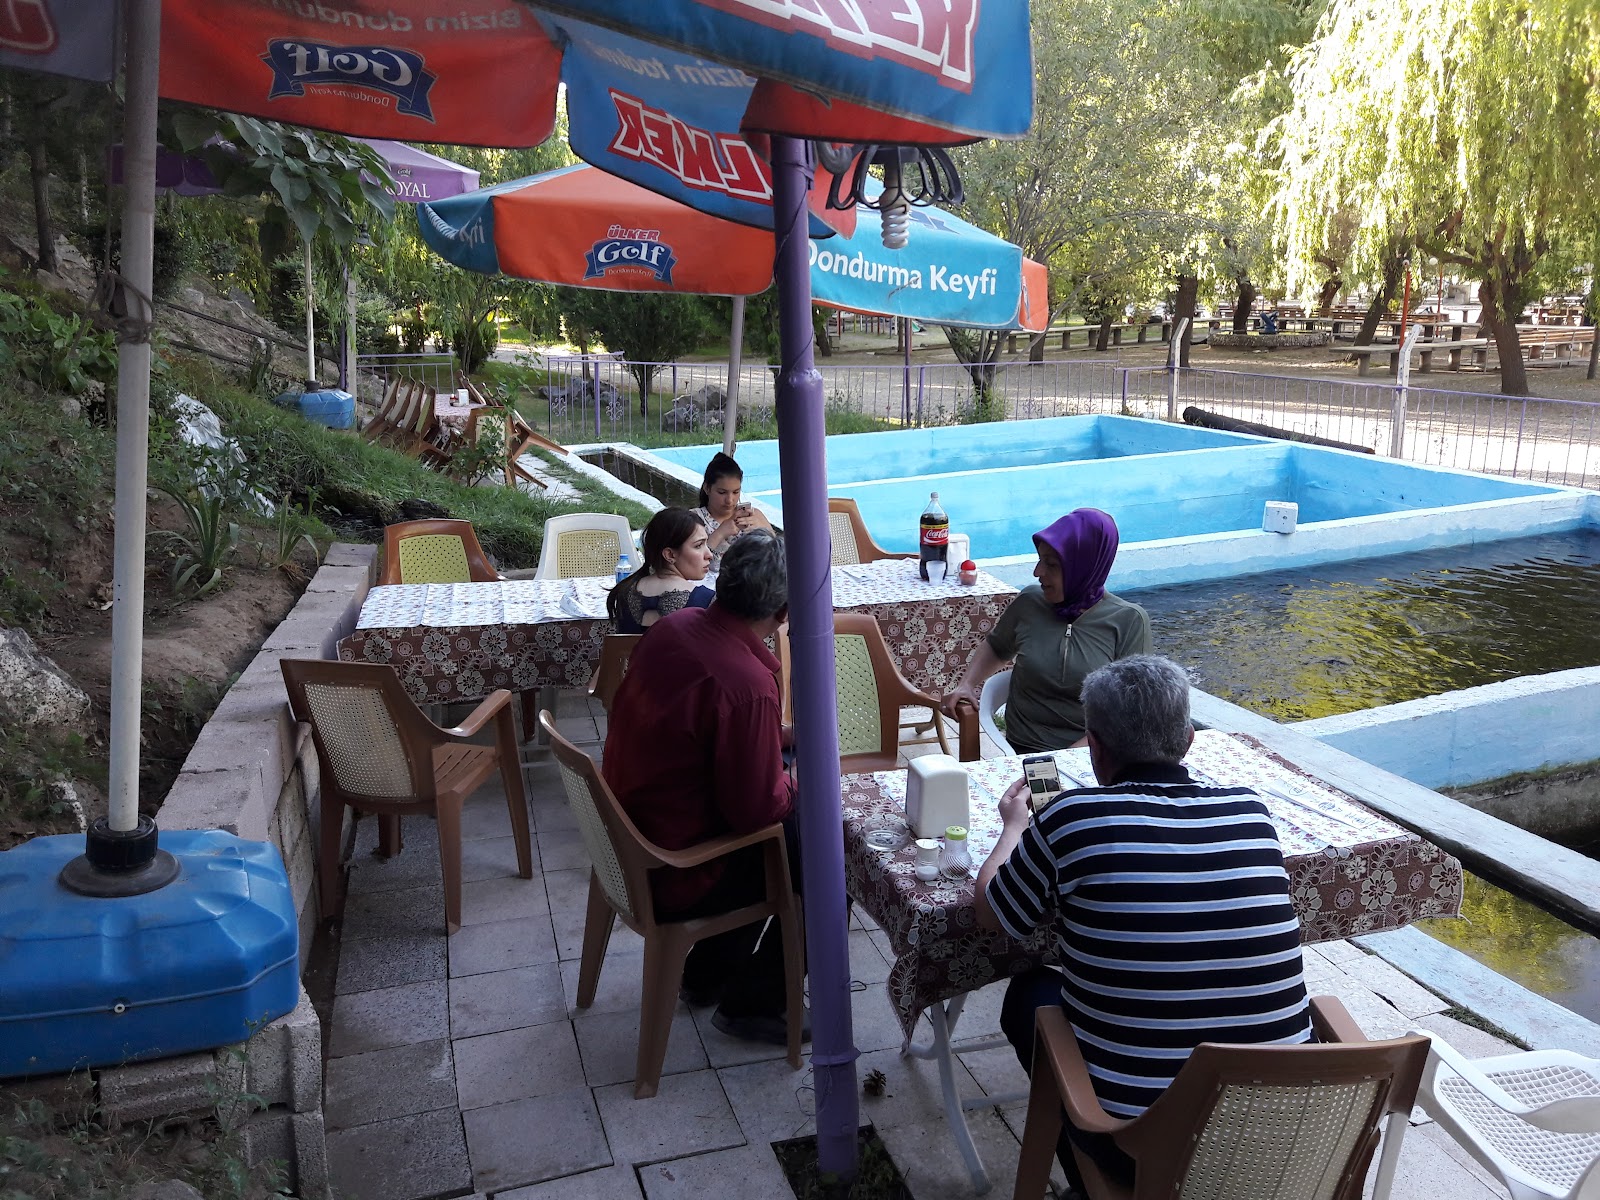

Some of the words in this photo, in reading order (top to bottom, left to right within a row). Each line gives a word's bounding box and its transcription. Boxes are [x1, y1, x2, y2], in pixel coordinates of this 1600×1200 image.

[606, 224, 660, 242] ÜLKER
[597, 241, 666, 267] Golf
[930, 264, 998, 300] Keyfi
